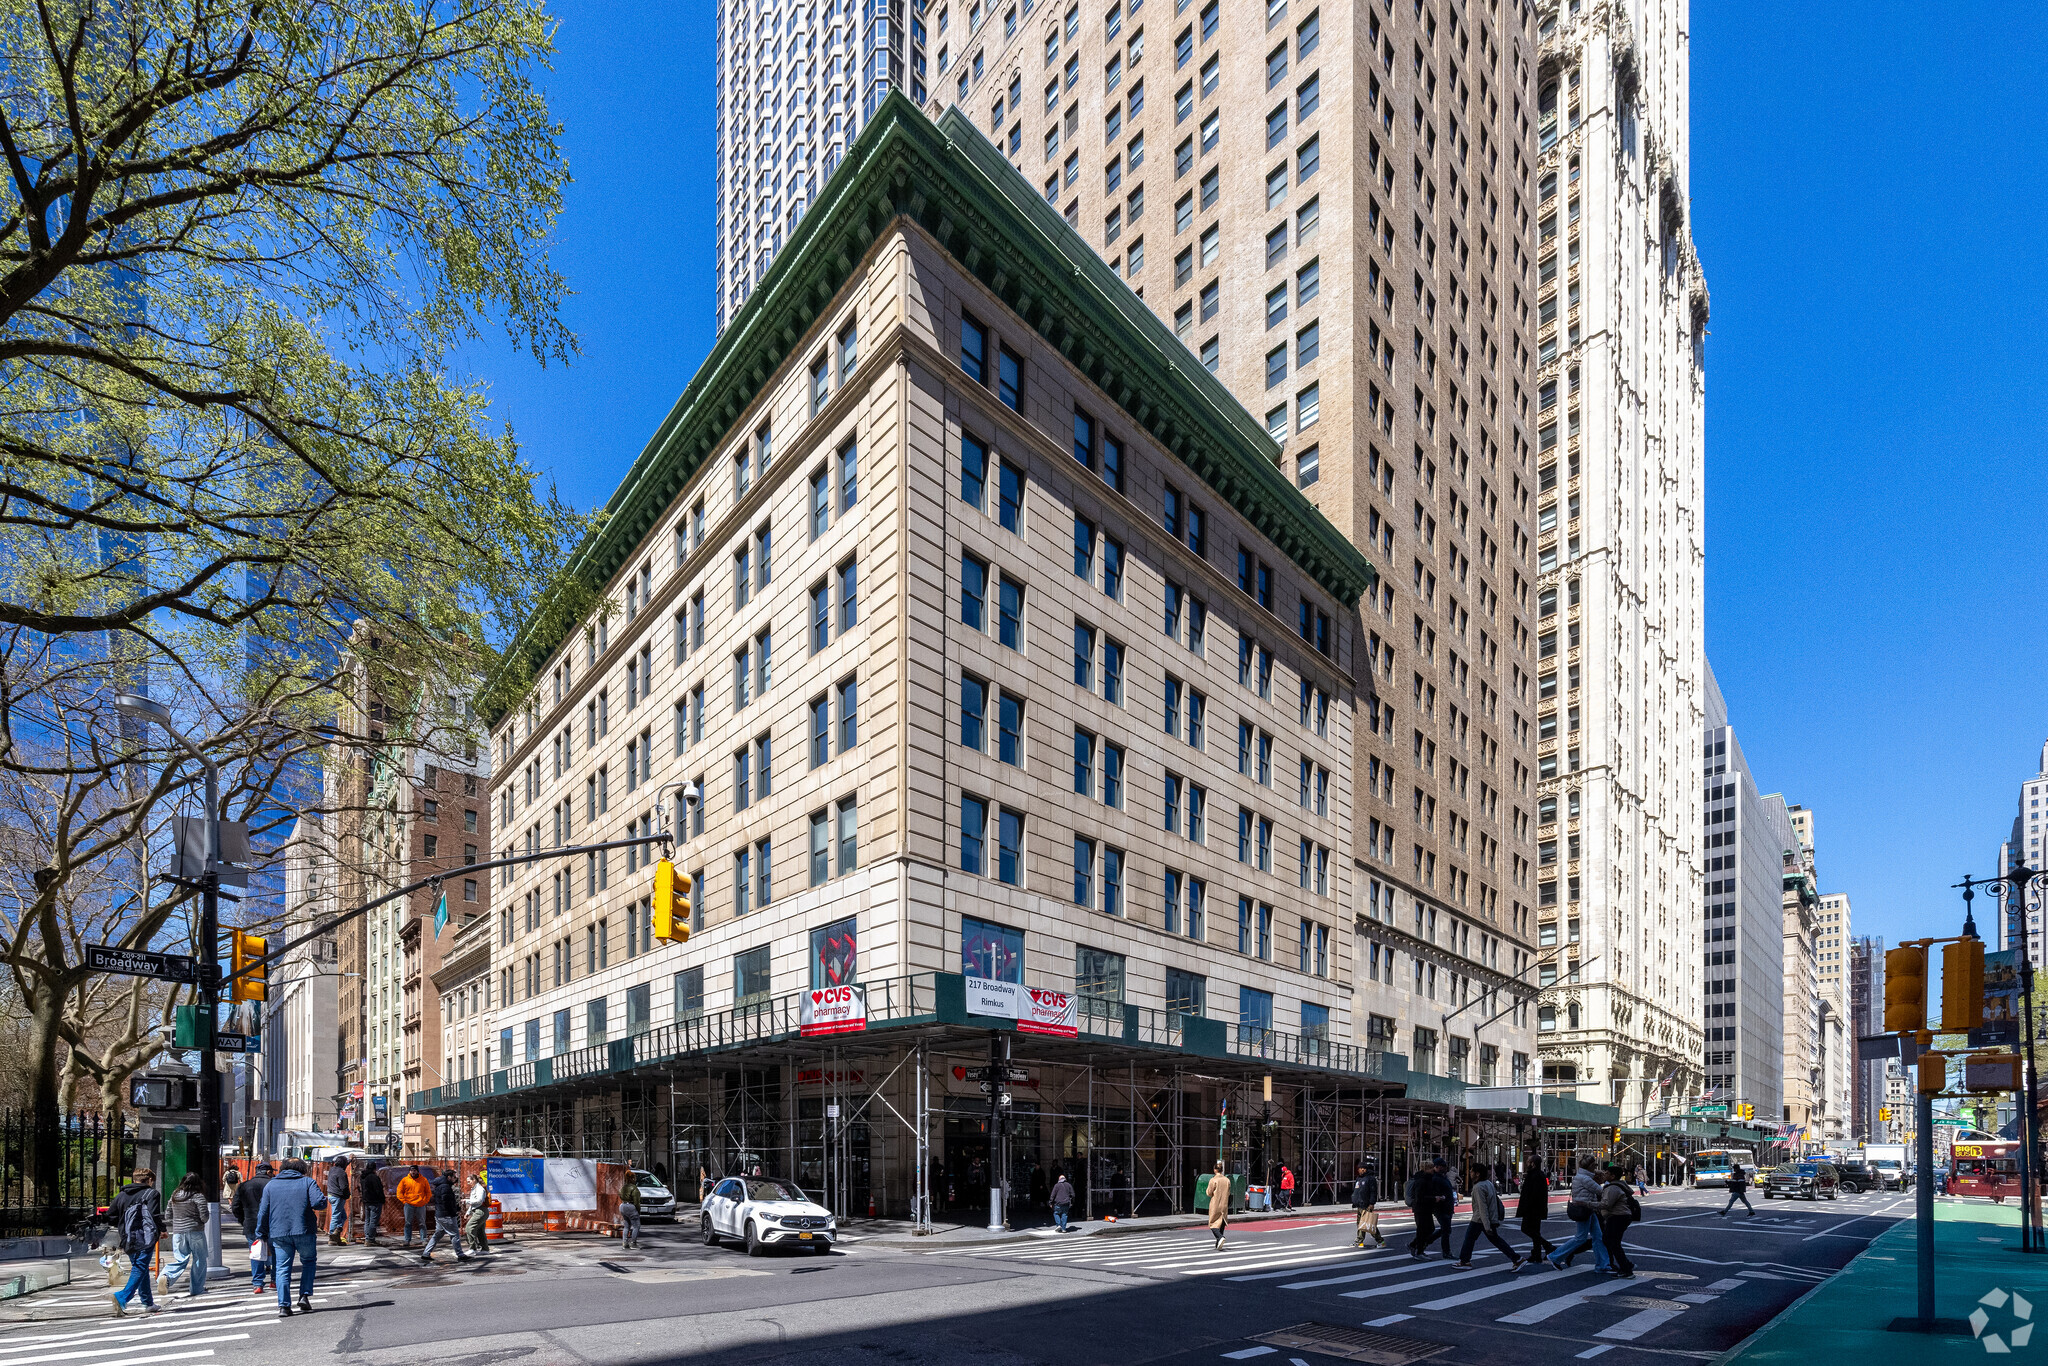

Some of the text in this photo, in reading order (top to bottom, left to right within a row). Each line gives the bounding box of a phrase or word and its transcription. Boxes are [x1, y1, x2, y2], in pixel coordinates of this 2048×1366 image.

[96, 954, 158, 972] Broadway
[969, 980, 1015, 995] 217 Broadway
[824, 987, 851, 1004] CVS
[1043, 991, 1066, 1008] CVS
[982, 998, 1004, 1008] Rimkus
[814, 1006, 850, 1019] pharmacy
[1032, 1006, 1065, 1019] pharmacy
[967, 1071, 978, 1079] Vesey
[1010, 1072, 1026, 1080] Broadway
